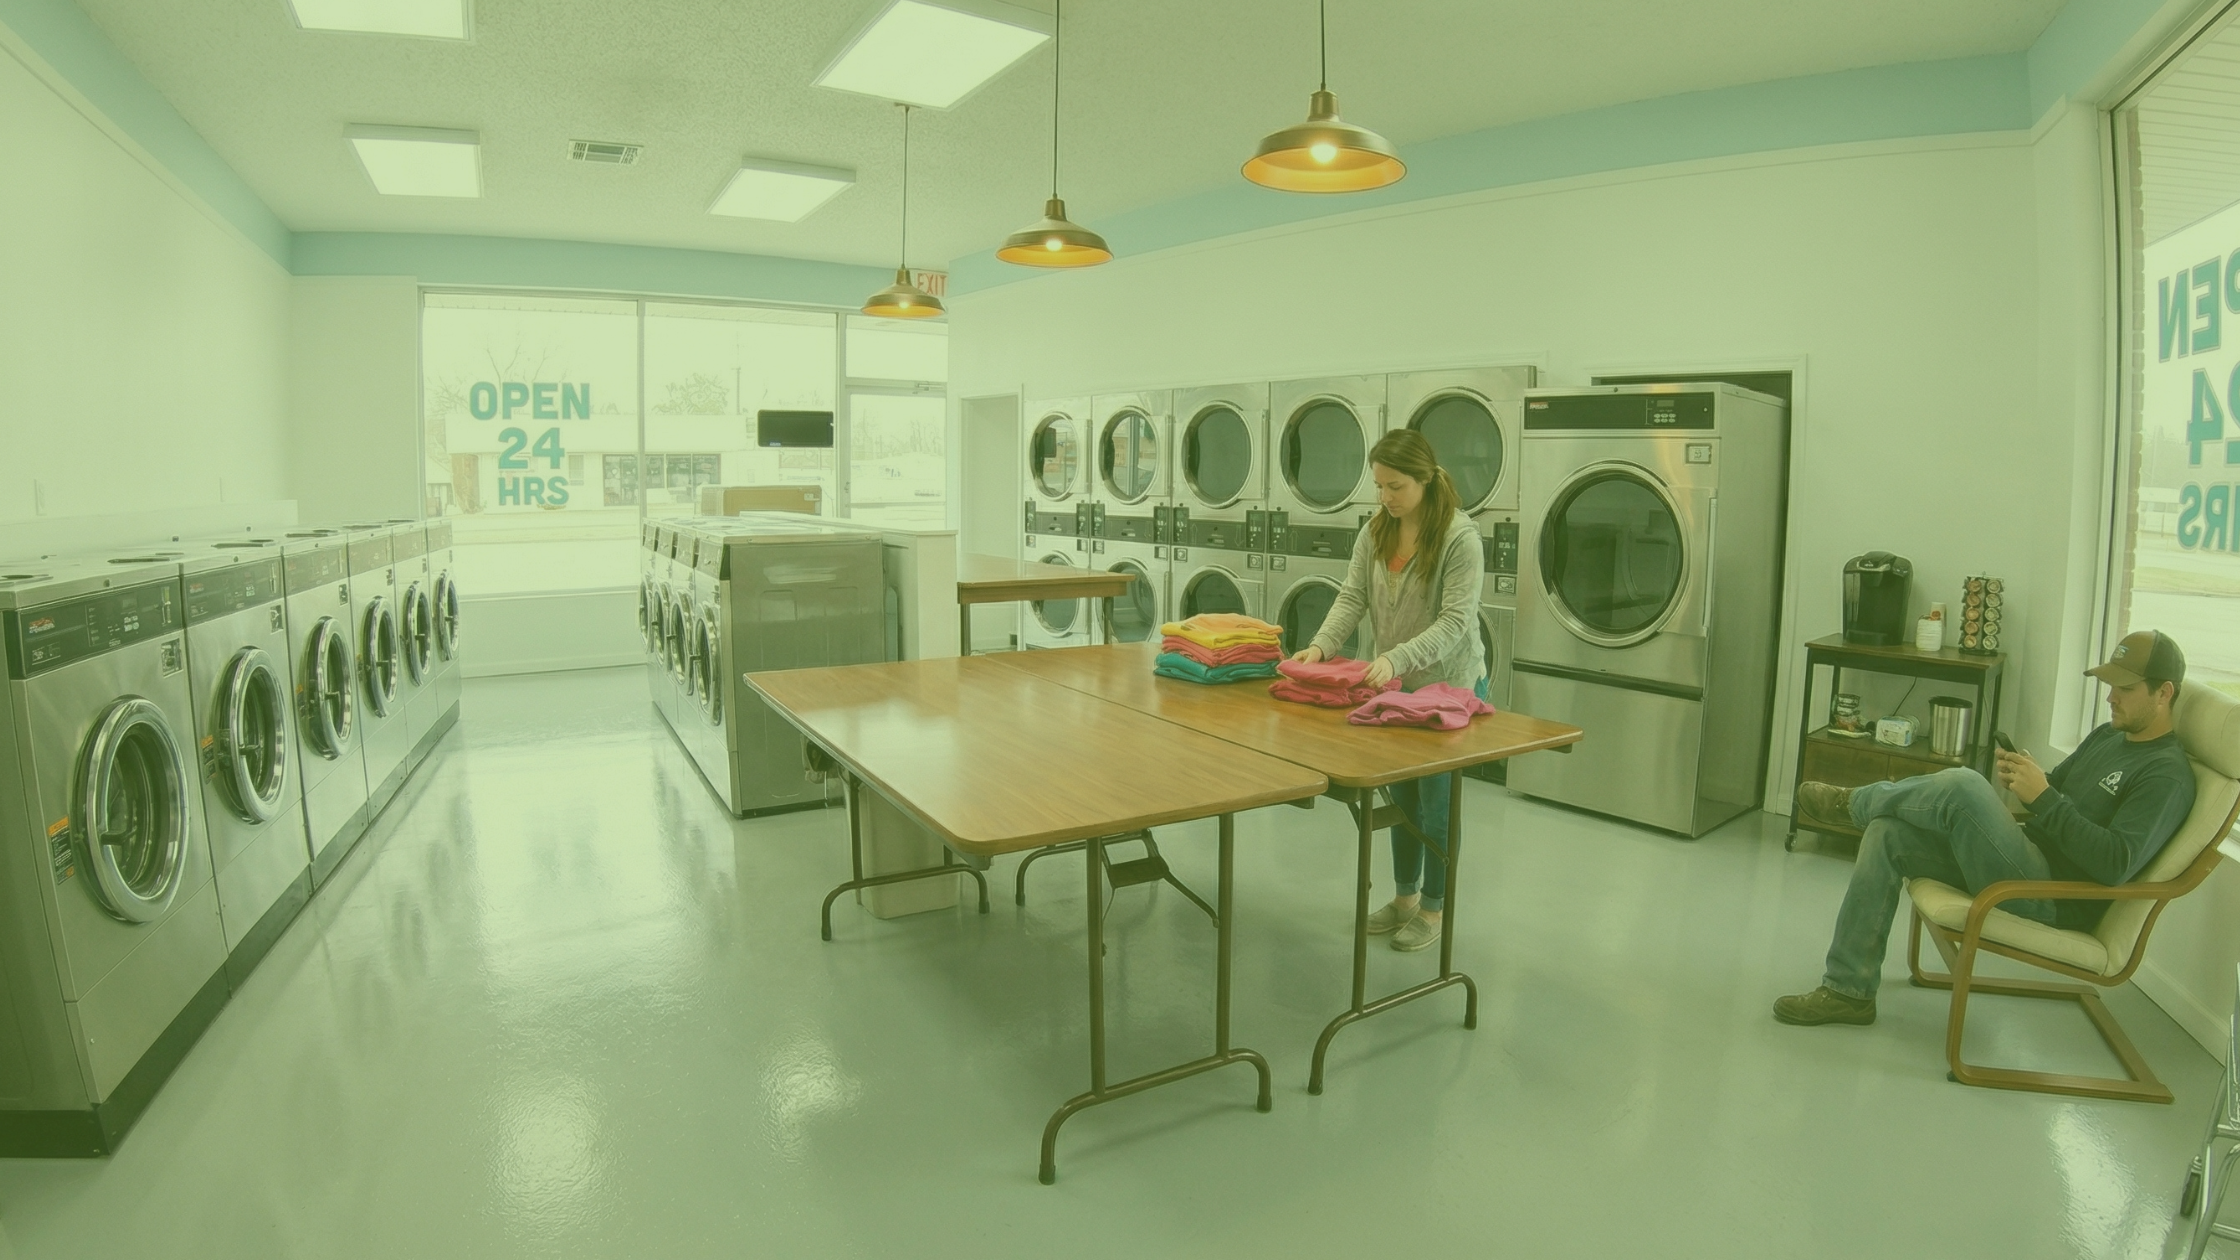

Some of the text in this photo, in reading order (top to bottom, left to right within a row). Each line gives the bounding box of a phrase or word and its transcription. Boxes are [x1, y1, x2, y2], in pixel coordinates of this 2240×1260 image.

[917, 273, 948, 297] EXIT
[469, 381, 590, 420] OPEN
[498, 427, 565, 469] 24
[498, 476, 569, 506] HRS
